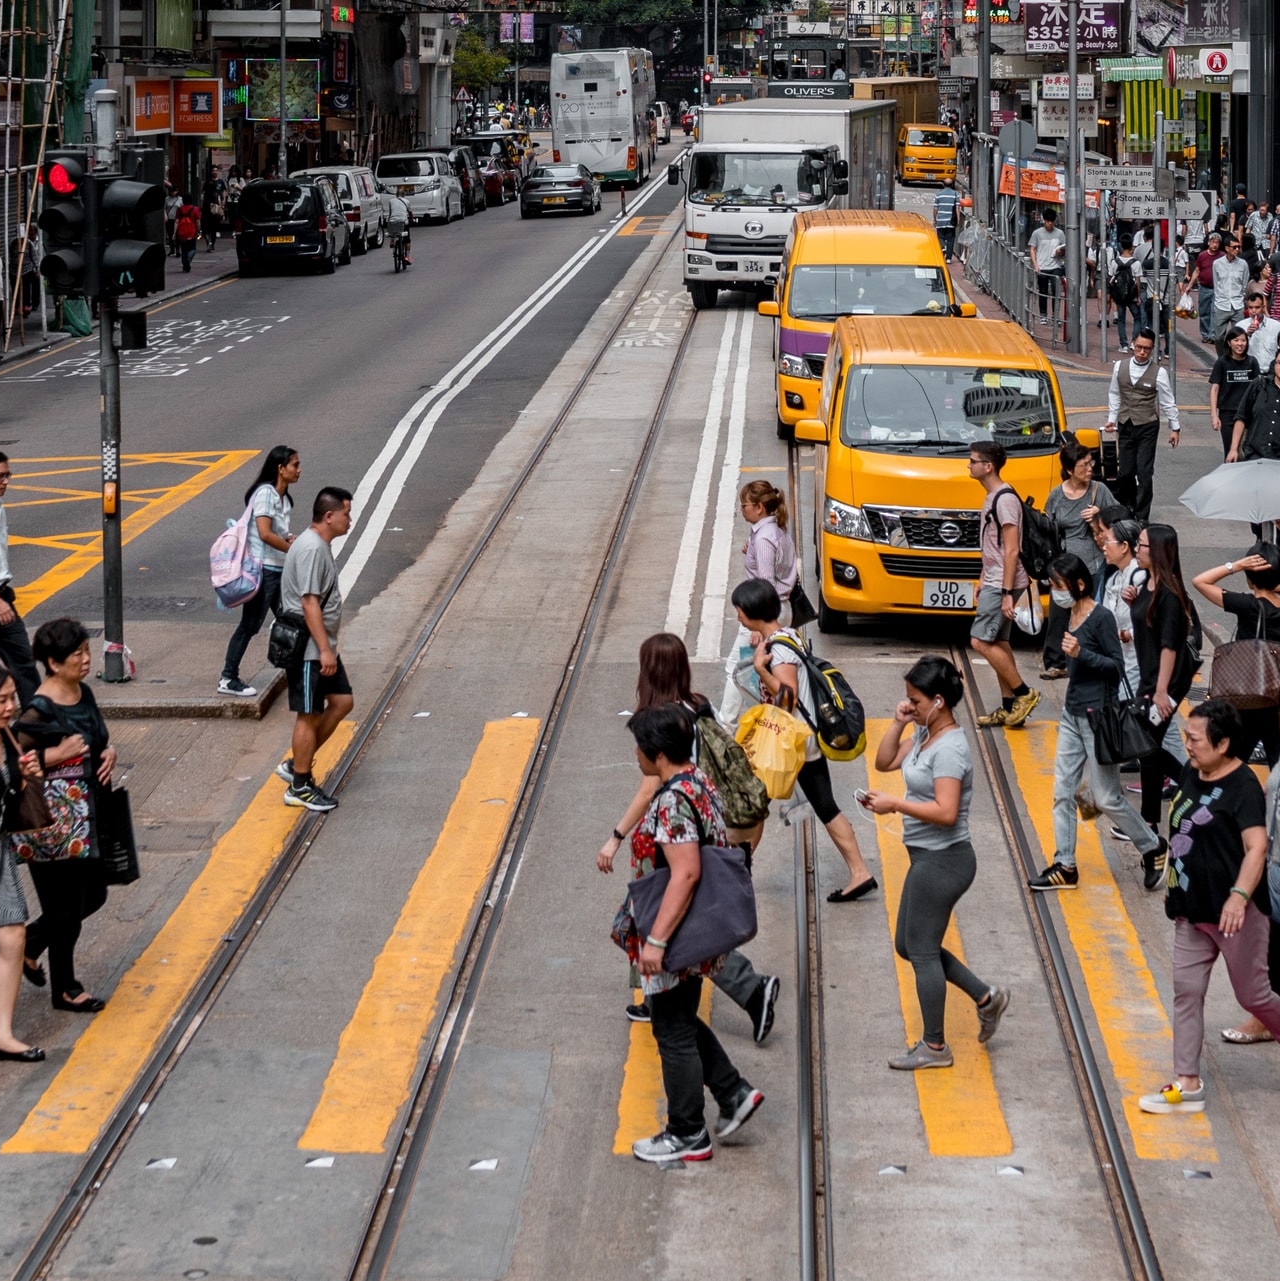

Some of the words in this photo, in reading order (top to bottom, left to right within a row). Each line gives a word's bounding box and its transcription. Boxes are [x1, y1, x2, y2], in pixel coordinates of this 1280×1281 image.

[799, 23, 817, 33] 67
[1028, 26, 1062, 39] $35
[784, 87, 835, 96] OLIVER'S
[1120, 194, 1143, 202] Stone
[1132, 207, 1177, 216] 石水渠
[938, 581, 959, 594] UD
[930, 594, 967, 608] 9816
